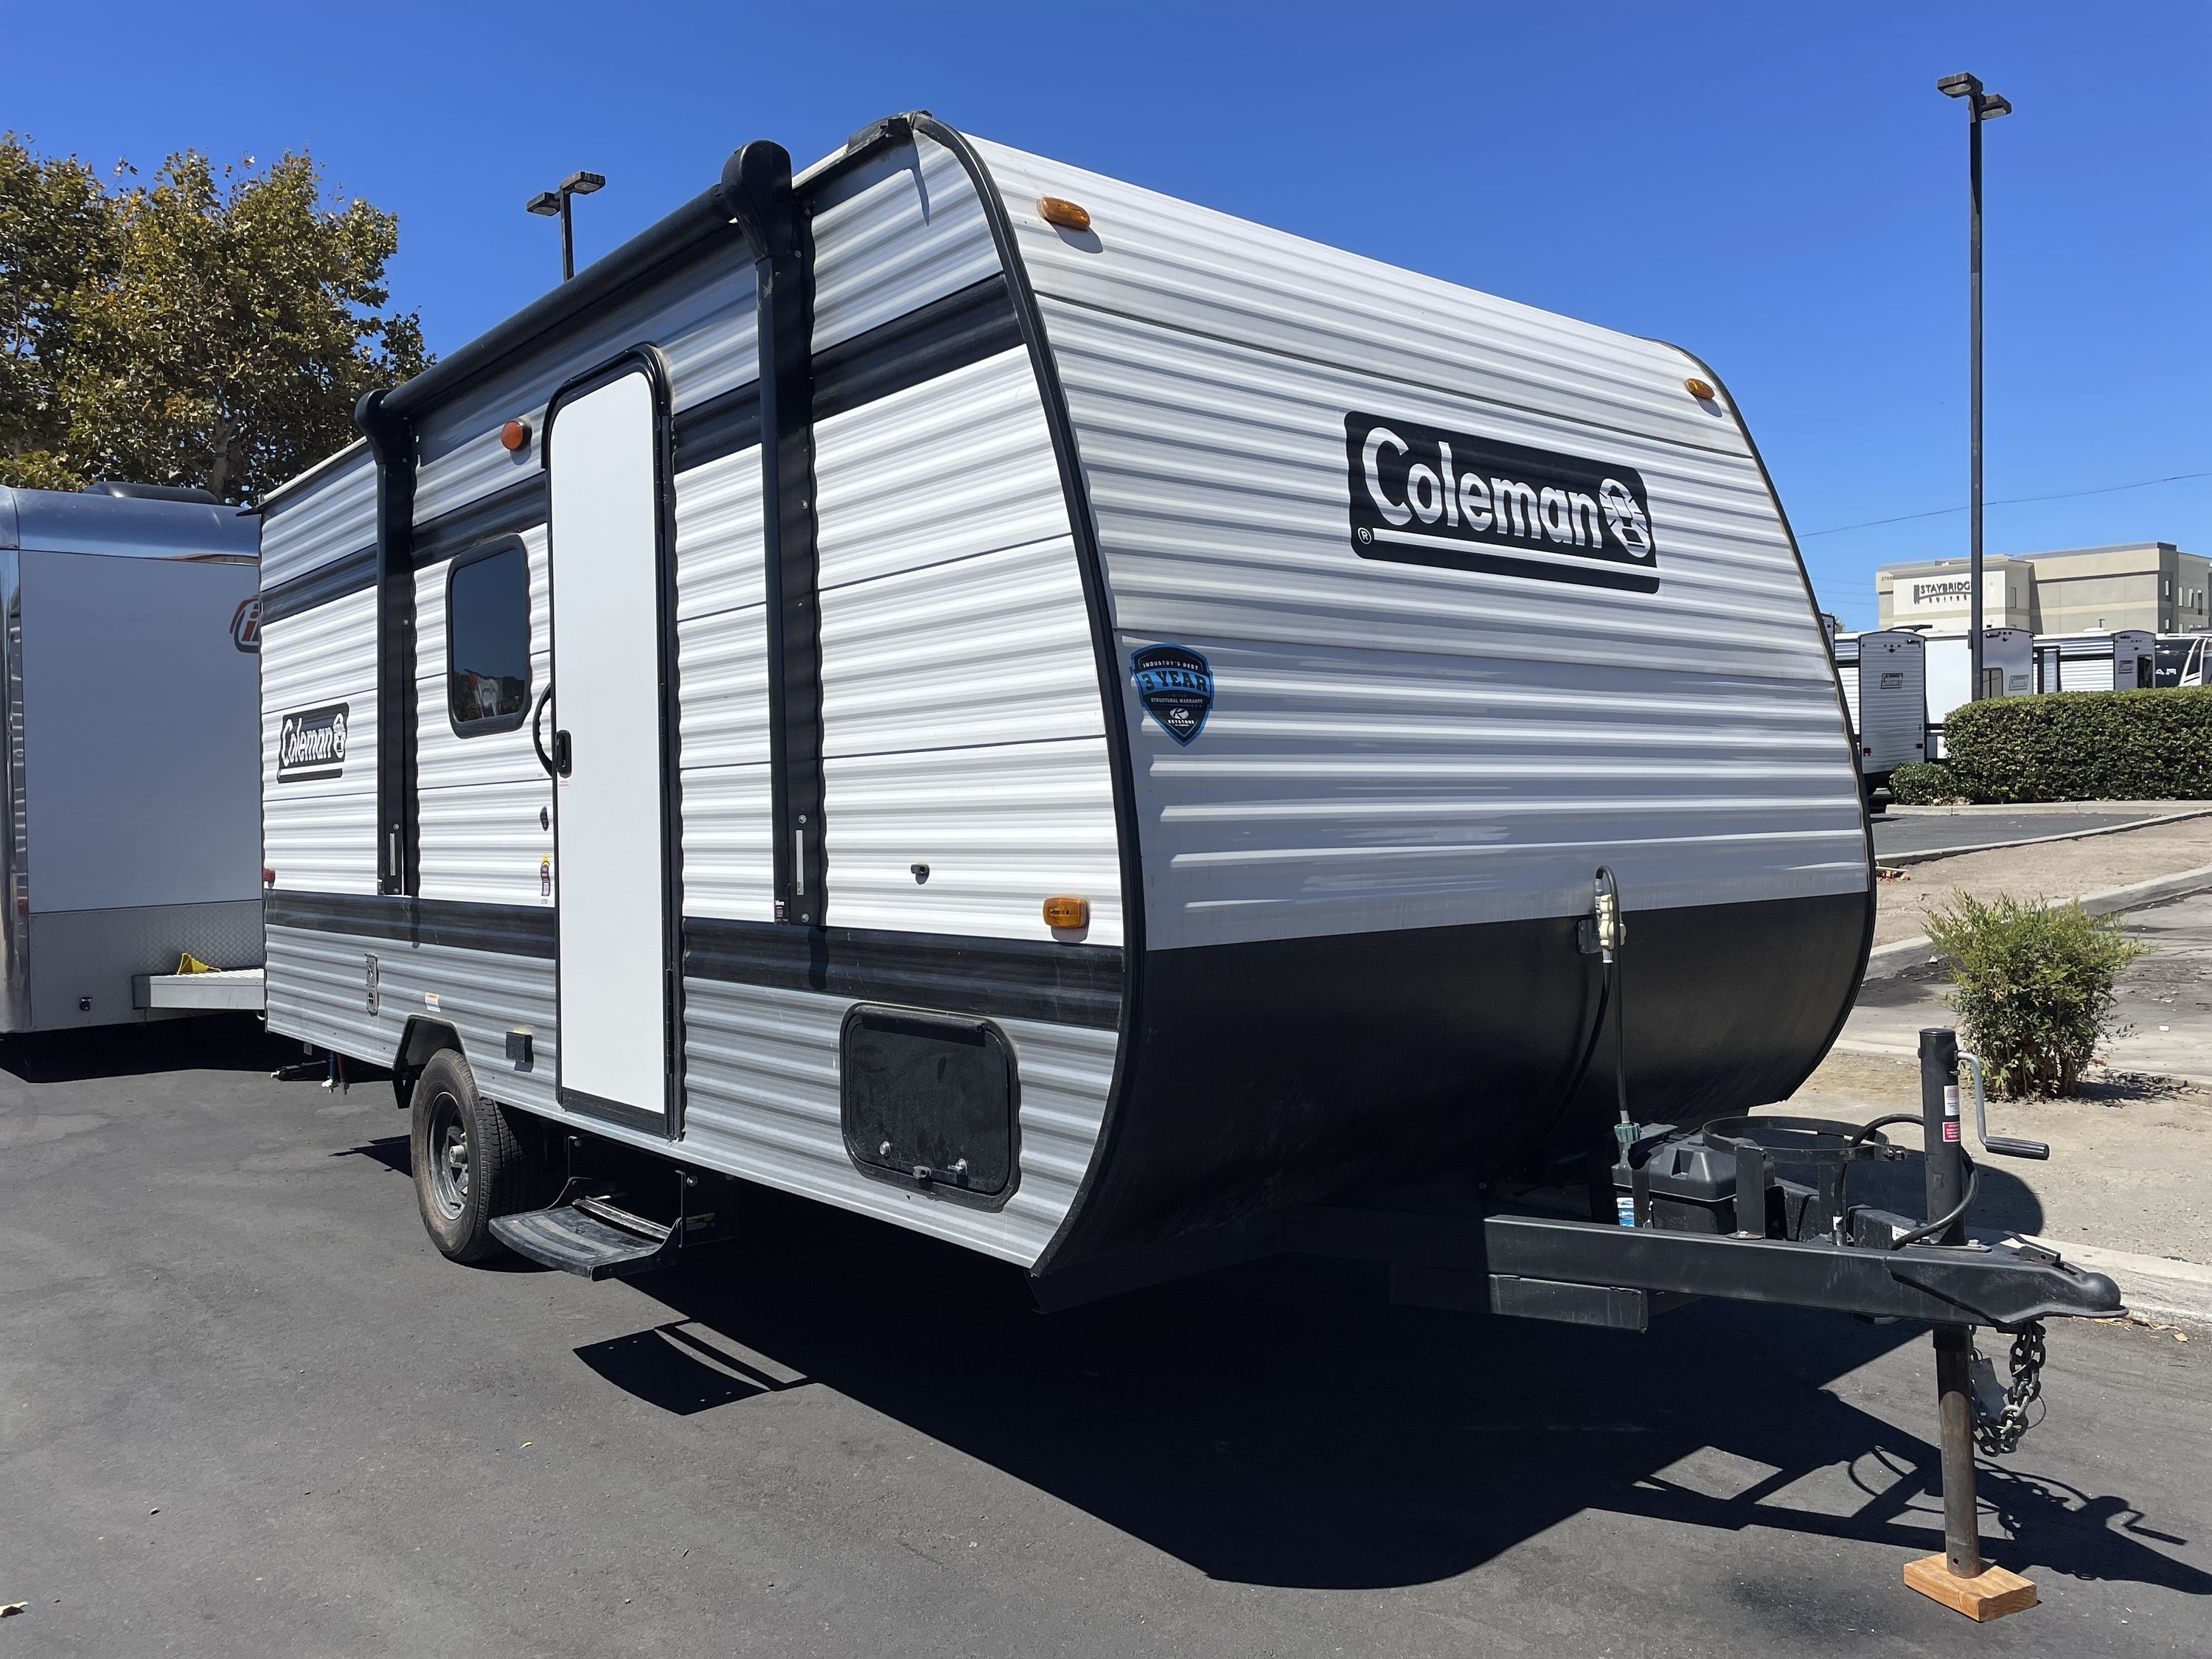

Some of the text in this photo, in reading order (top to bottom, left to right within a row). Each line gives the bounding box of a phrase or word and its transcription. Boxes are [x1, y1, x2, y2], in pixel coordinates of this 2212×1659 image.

[1362, 427, 1603, 549] Coleman
[1920, 581, 1971, 594] STAYBRIDG
[1143, 660, 1198, 670] INDUSTRY'S BEST
[1141, 670, 1208, 692] 3 YEAR
[282, 717, 333, 767] Coleman
